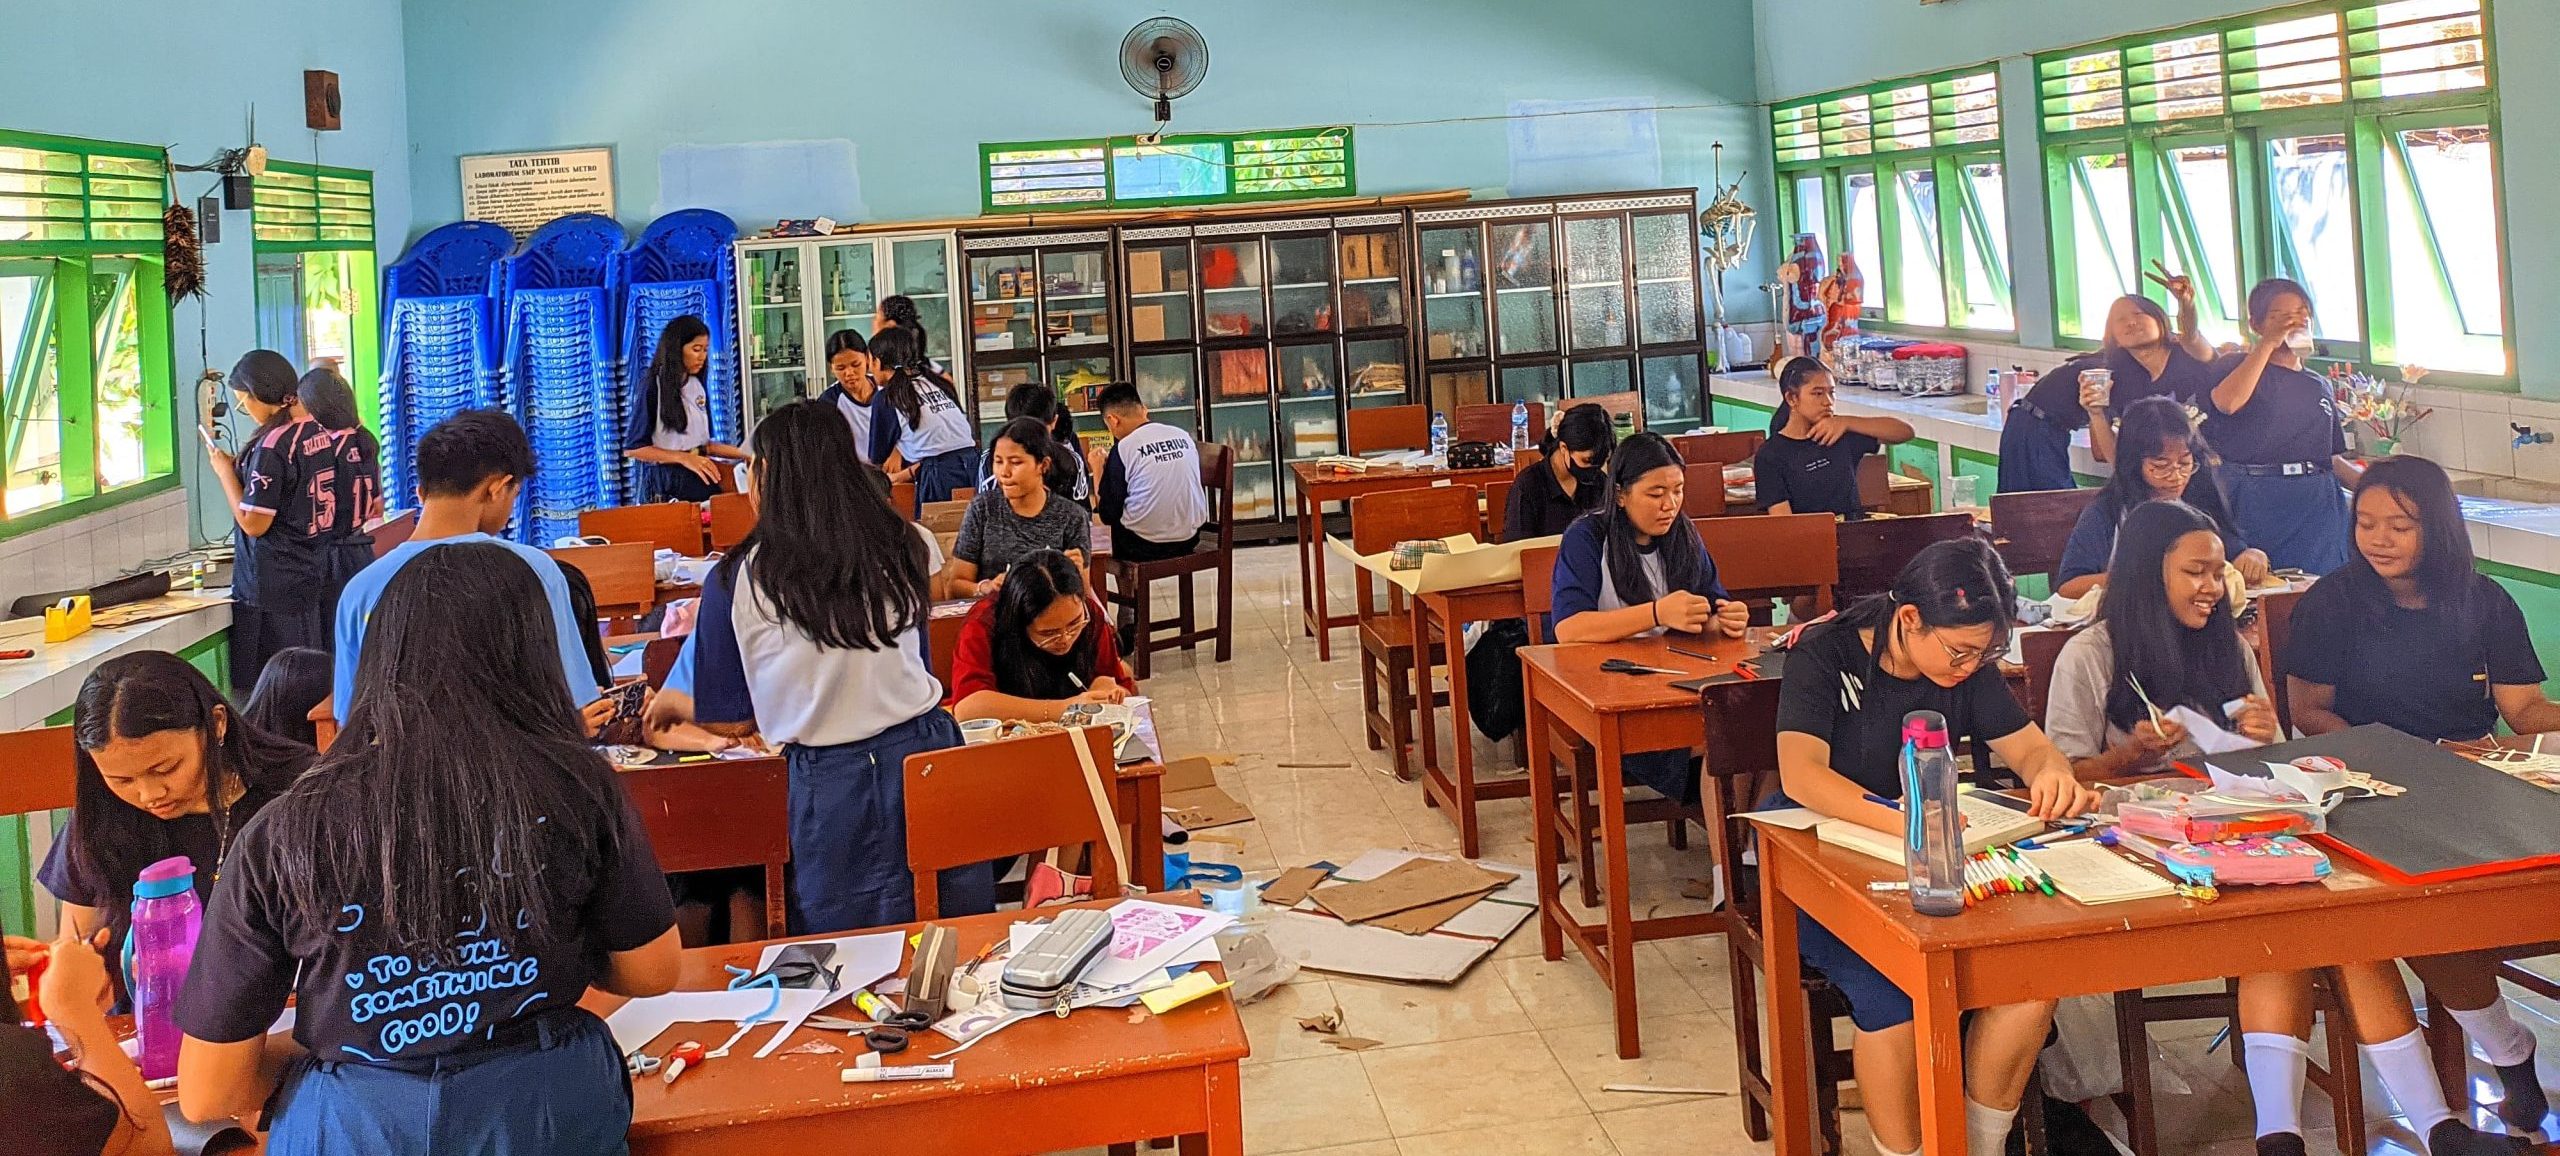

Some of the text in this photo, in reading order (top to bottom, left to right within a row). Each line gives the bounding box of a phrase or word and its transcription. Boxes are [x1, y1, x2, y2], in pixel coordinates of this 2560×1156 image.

[509, 157, 560, 168] TATA TERTIB
[474, 170, 520, 179] LABORATORIUM
[537, 166, 570, 174] XAVERIUS
[929, 402, 956, 413] METRO
[1138, 438, 1189, 458] XAVERIUS
[1155, 451, 1184, 463] METRO
[368, 956, 411, 983] TO
[351, 957, 538, 1023] SOMETHING
[380, 1002, 481, 1053] GOOD!
